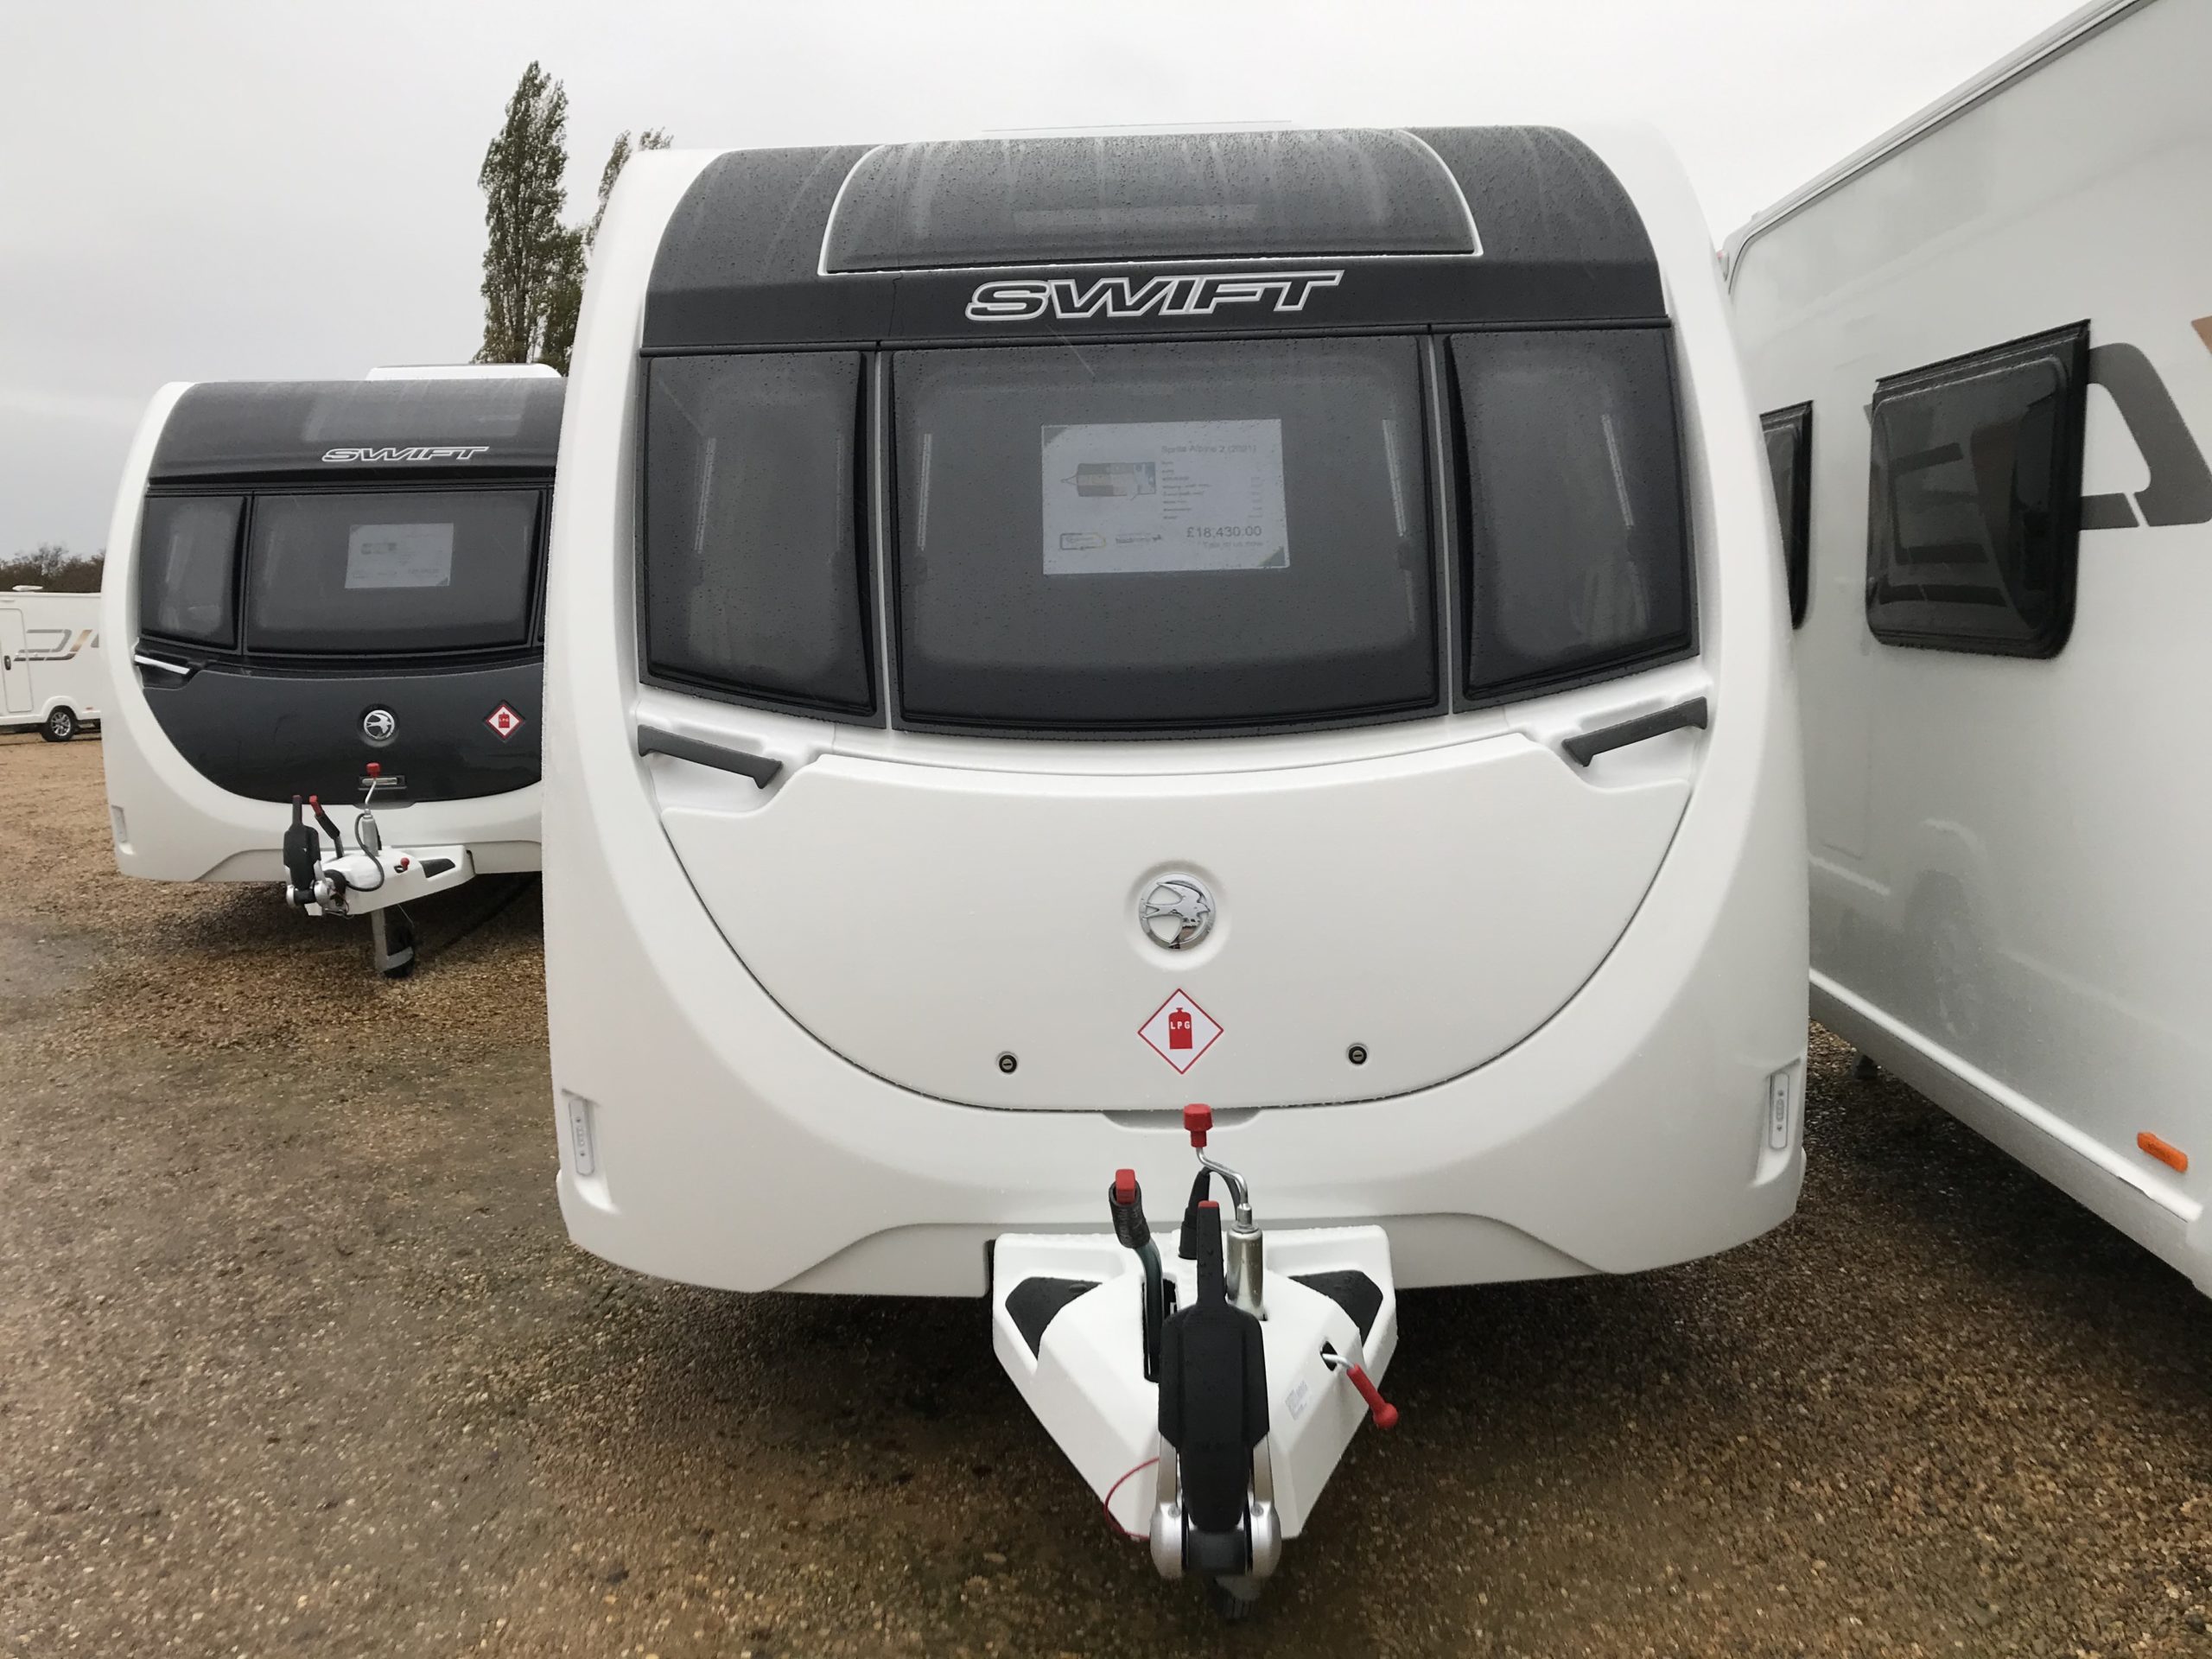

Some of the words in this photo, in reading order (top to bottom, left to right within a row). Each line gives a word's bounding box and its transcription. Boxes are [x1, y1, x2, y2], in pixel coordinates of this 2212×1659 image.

[965, 270, 1344, 321] SWIFT
[321, 446, 490, 462] SWIFT
[1186, 525, 1262, 538] £18,430.00
[1170, 1020, 1191, 1030] LPG
